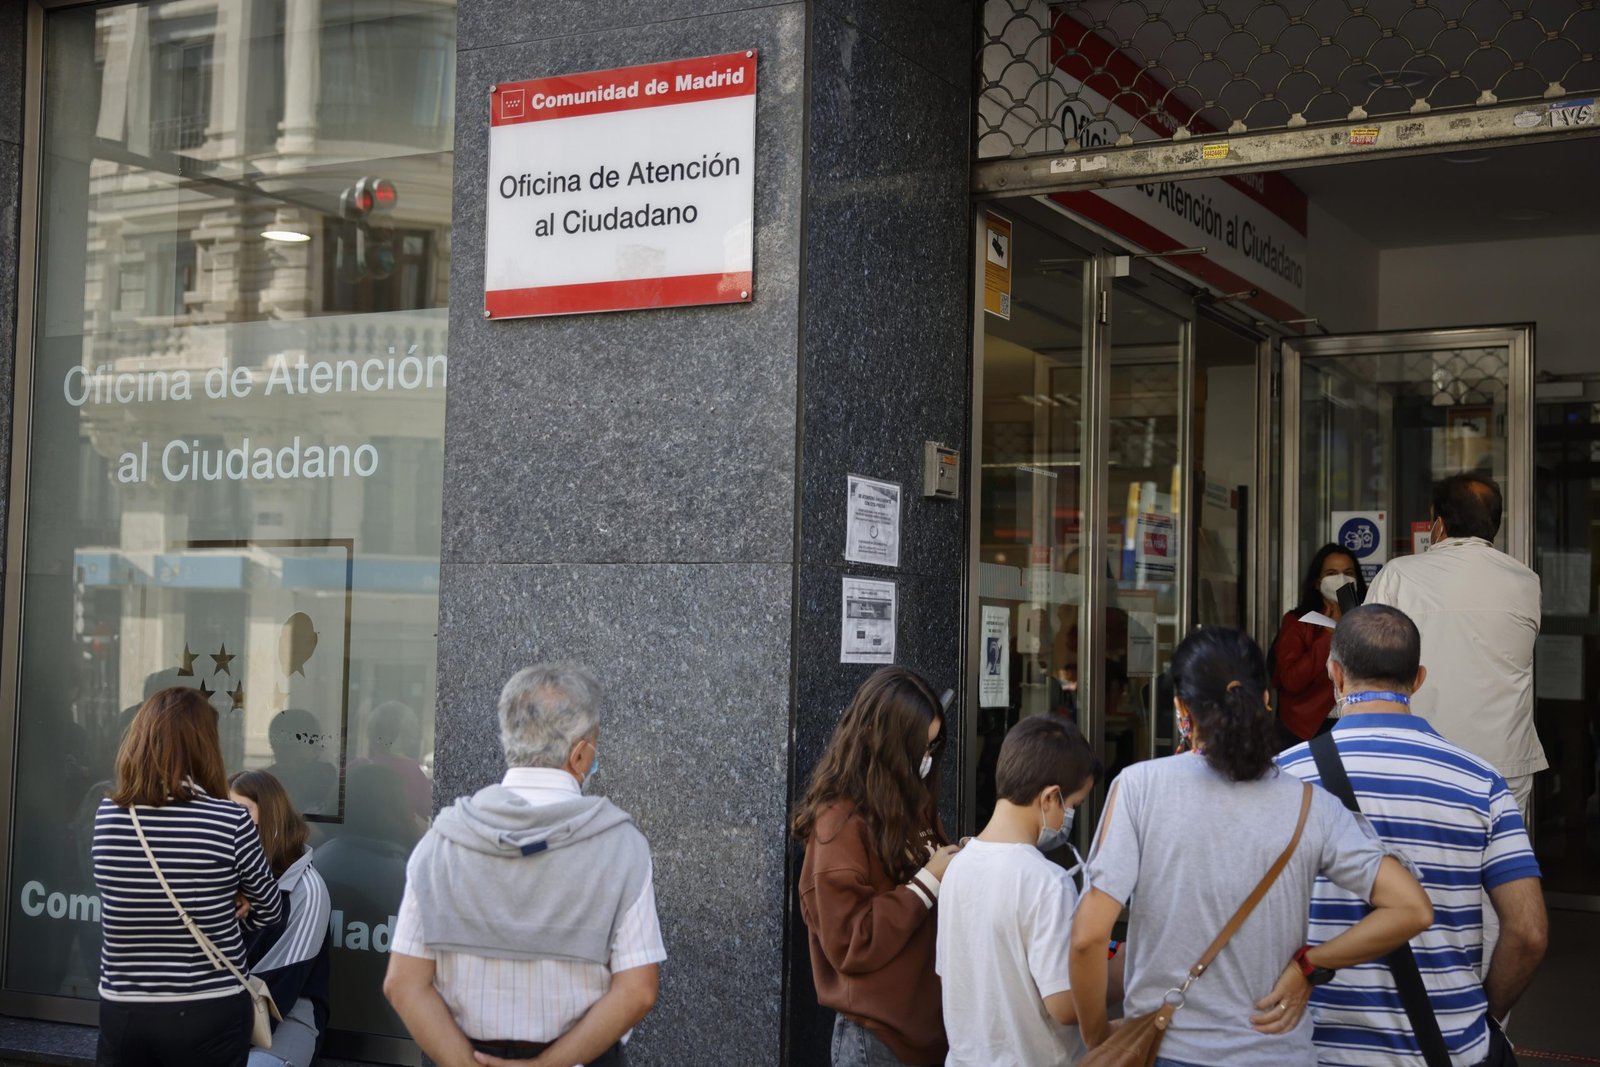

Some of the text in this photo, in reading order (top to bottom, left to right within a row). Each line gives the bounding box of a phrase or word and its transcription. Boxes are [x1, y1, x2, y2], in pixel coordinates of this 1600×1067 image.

[532, 67, 745, 110] Comunidad de Madrid
[500, 152, 740, 199] Oficina de Atención
[534, 203, 698, 237] al Ciudadano
[1158, 181, 1222, 240] Atención
[1226, 215, 1238, 250] al
[1242, 221, 1303, 289] Ciudadano
[63, 345, 448, 407] Oficina de Atención
[117, 436, 379, 483] al Ciudadano
